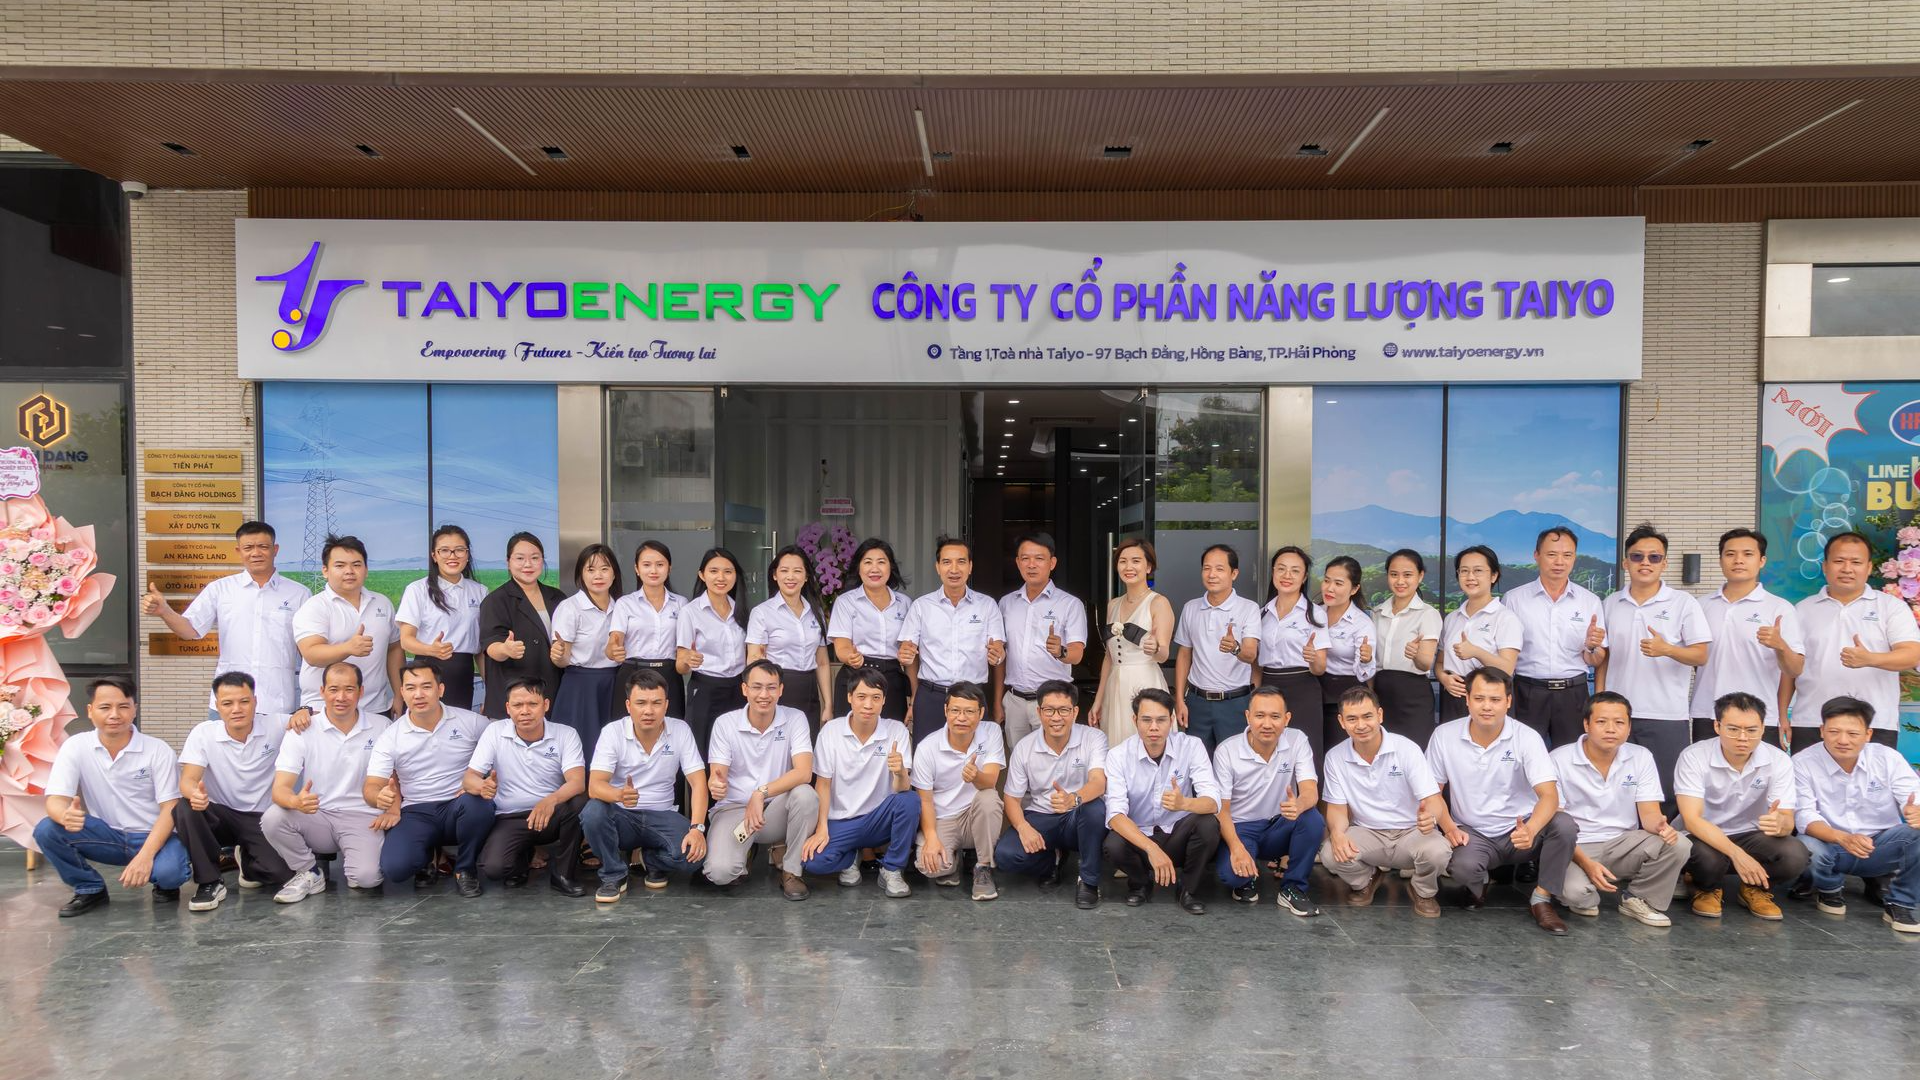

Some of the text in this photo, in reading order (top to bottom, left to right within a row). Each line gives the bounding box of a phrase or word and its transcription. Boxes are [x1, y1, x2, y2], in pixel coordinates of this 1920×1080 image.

[382, 281, 840, 321] TAIYOENERGY
[872, 257, 1615, 329] CÔNG TY CỔ PHẦN NĂNG LƯỢNG TAIYO
[420, 340, 508, 360] Empowering
[514, 341, 572, 362] Futures
[628, 347, 649, 362] tạo
[649, 339, 695, 362] Tương
[698, 347, 717, 360] lai
[949, 345, 982, 362] Tầng
[1018, 346, 1043, 360] nhà
[1046, 346, 1085, 362] Taiyo
[1095, 347, 1112, 360] 97
[1115, 347, 1148, 362] Bạch
[1312, 345, 1357, 361] Phòng
[1402, 345, 1545, 360] www.taiyoenergy.vn
[1770, 387, 1834, 437] MỚI
[193, 461, 214, 470] PHÁT
[1868, 464, 1910, 478] LINE
[211, 522, 221, 530] TK
[177, 553, 204, 561] KHANG
